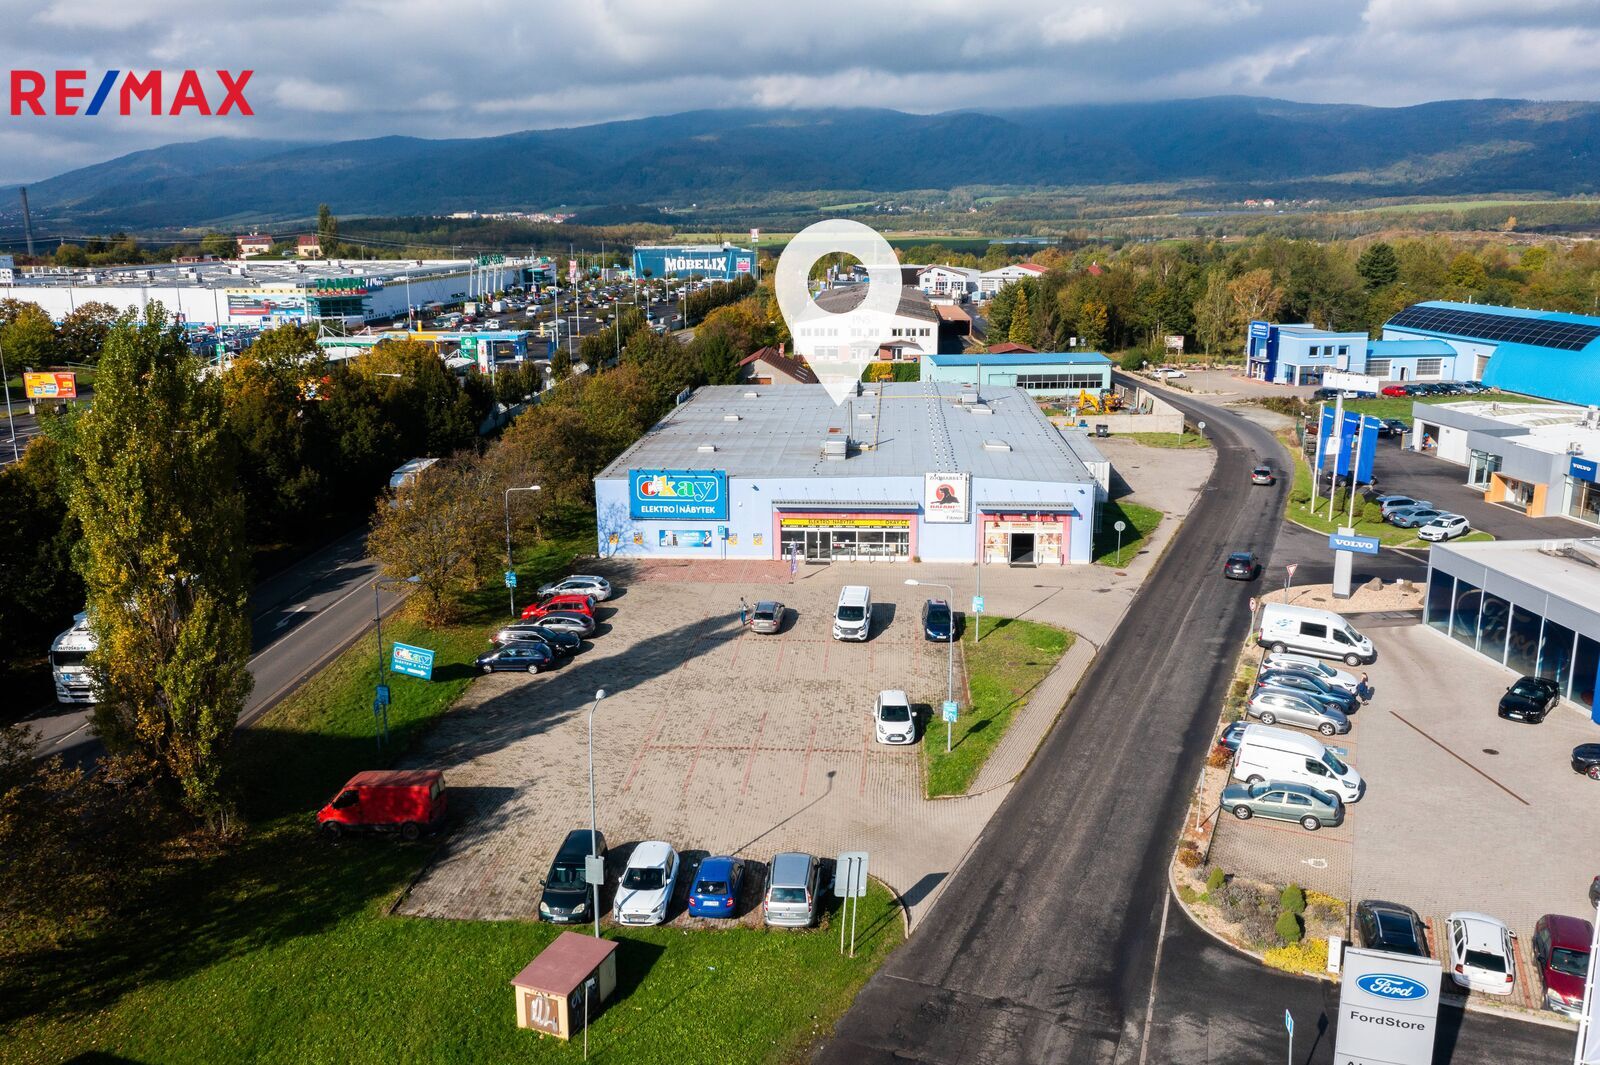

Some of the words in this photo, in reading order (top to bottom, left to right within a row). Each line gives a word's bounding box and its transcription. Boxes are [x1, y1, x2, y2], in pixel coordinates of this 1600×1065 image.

[664, 256, 727, 272] MÖBELIX
[1572, 462, 1592, 472] VOLVO
[641, 505, 675, 513] ELEKTRO
[679, 504, 716, 514] NÁBYTEK
[1334, 538, 1374, 549] VOLVO
[1370, 978, 1414, 997] Ford
[1350, 1011, 1425, 1030] FordStore
